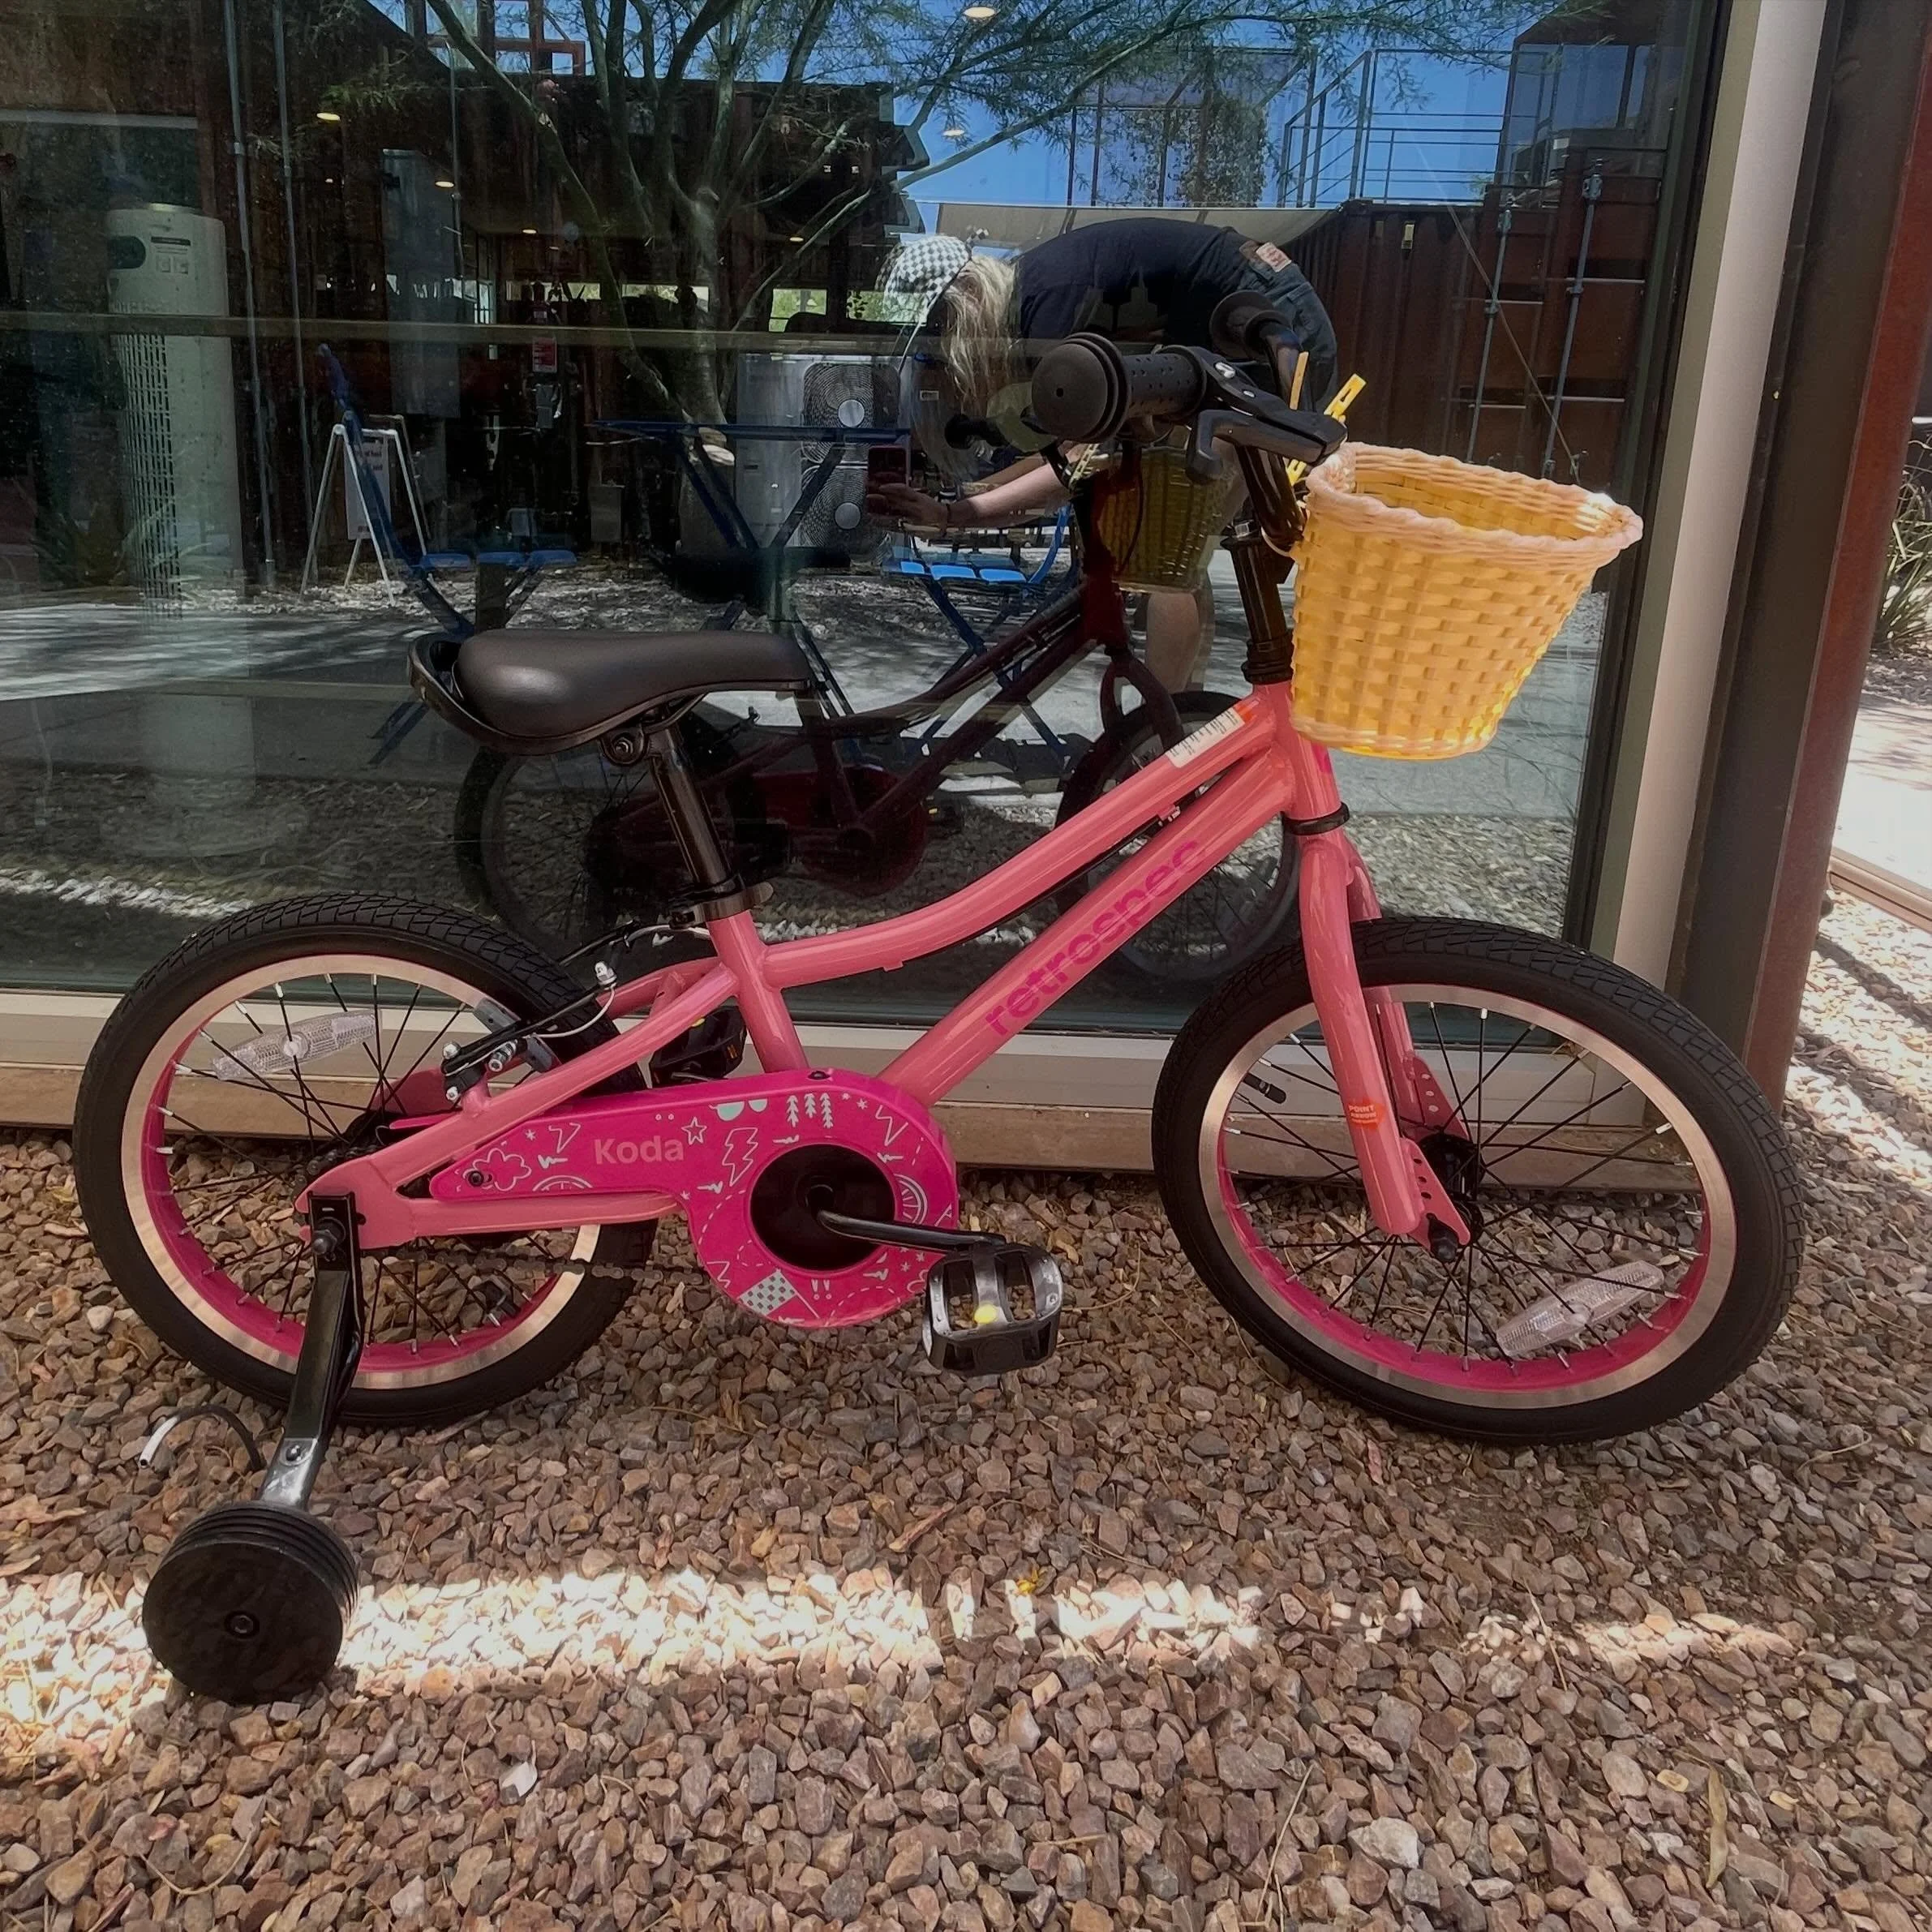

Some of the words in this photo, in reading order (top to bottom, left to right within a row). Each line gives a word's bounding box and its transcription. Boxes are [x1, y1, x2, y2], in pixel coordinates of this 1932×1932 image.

[985, 839, 1200, 1037] retrospec
[1349, 1104, 1374, 1113] POINT
[594, 1135, 684, 1166] Koda
